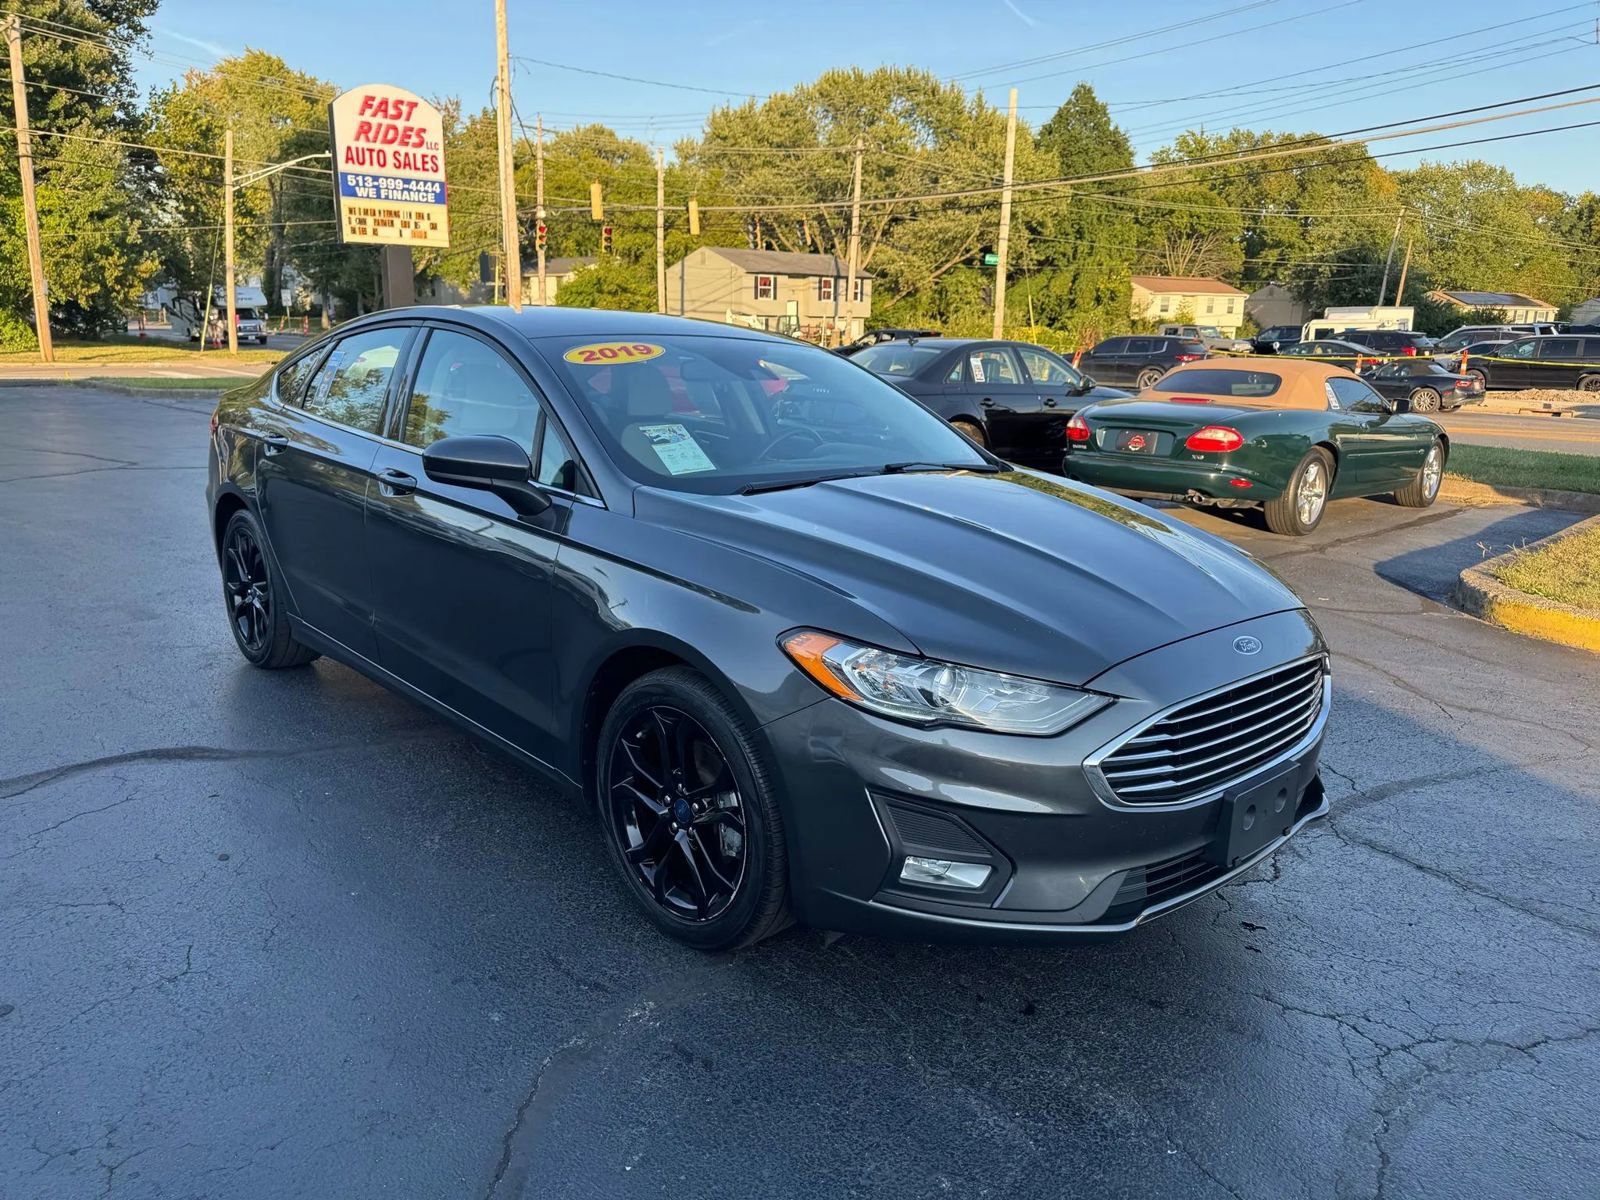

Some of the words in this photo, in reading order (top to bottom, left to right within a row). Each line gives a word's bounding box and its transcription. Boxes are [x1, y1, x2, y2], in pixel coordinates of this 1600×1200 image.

[358, 95, 418, 122] FAST
[354, 120, 427, 149] RIDES
[426, 141, 440, 151] LLC
[345, 146, 387, 168] AUTO
[393, 150, 439, 173] SALES
[347, 174, 441, 194] 513-999-4444
[355, 186, 377, 198] WE
[380, 189, 436, 203] FINANCE
[578, 344, 654, 362] 2019
